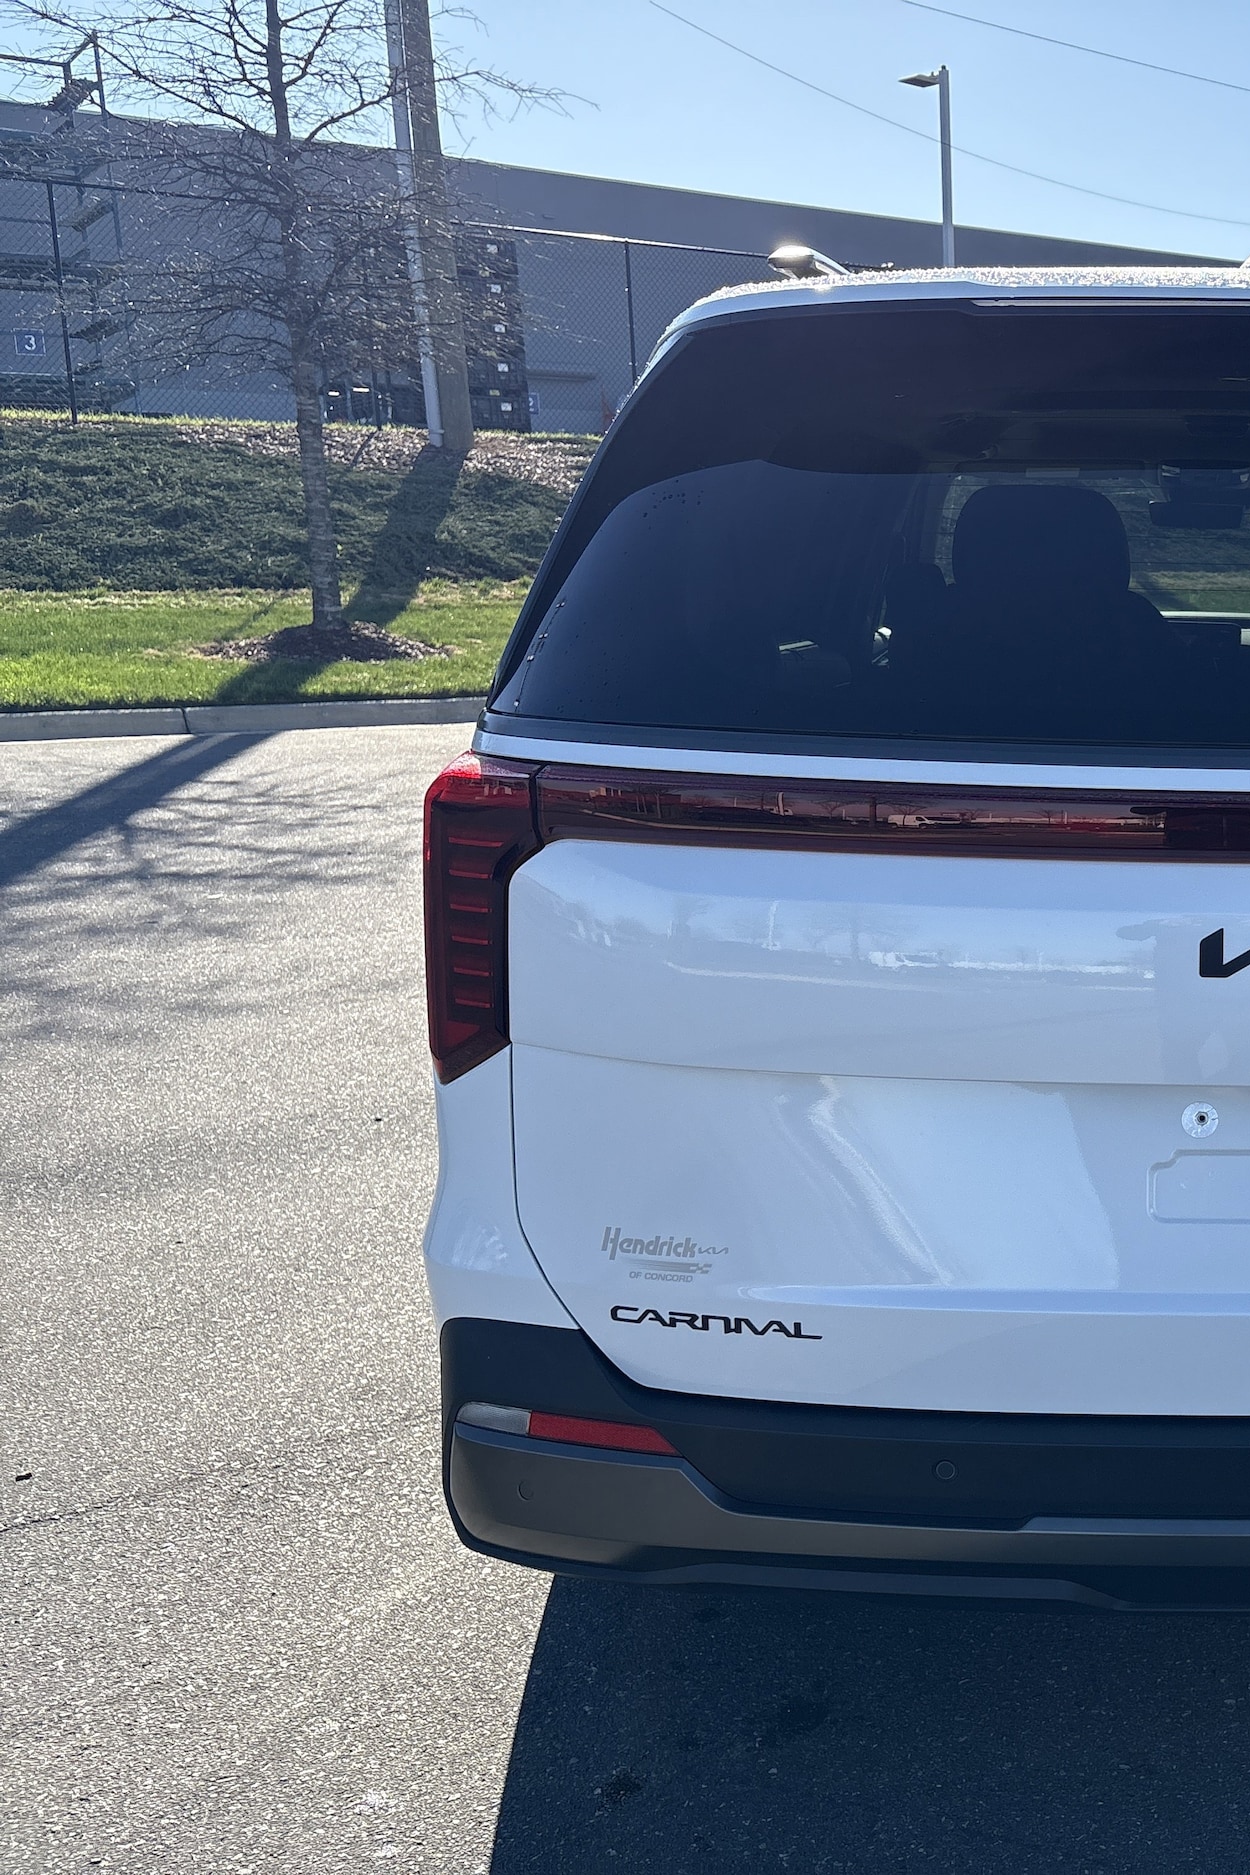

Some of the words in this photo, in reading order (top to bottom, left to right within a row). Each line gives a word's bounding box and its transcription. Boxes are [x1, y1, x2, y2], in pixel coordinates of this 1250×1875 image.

[24, 334, 37, 351] 3
[601, 1226, 697, 1261] Hendrick
[629, 1271, 642, 1280] OF
[644, 1272, 693, 1283] CONCORD
[610, 1305, 823, 1340] CARNIVAL
